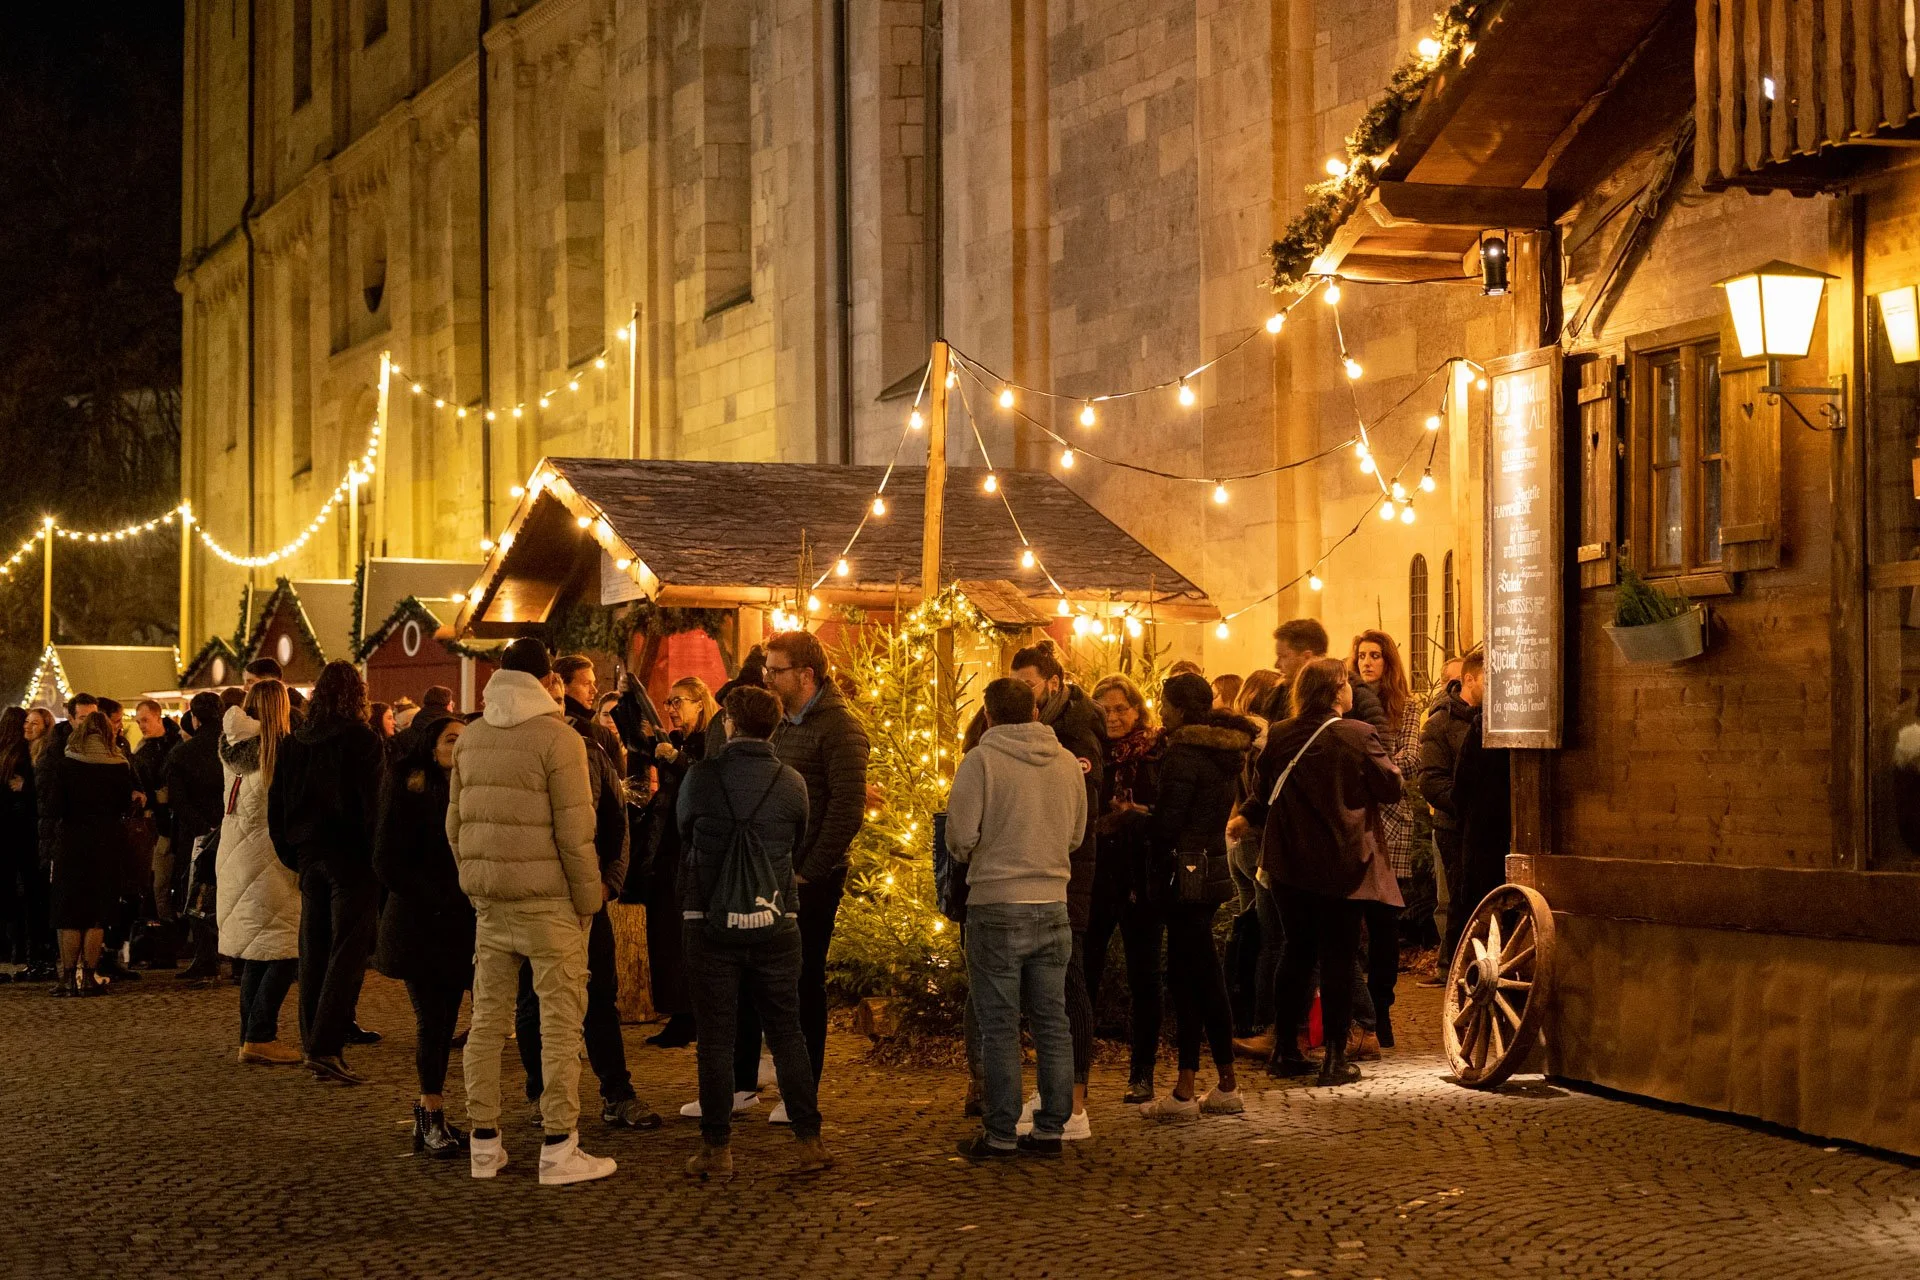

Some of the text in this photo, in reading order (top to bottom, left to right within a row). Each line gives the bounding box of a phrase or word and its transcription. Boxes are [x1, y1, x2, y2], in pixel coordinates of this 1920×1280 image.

[1529, 403, 1548, 430] ALP
[1491, 649, 1518, 675] Weine
[726, 909, 775, 929] PUMA
